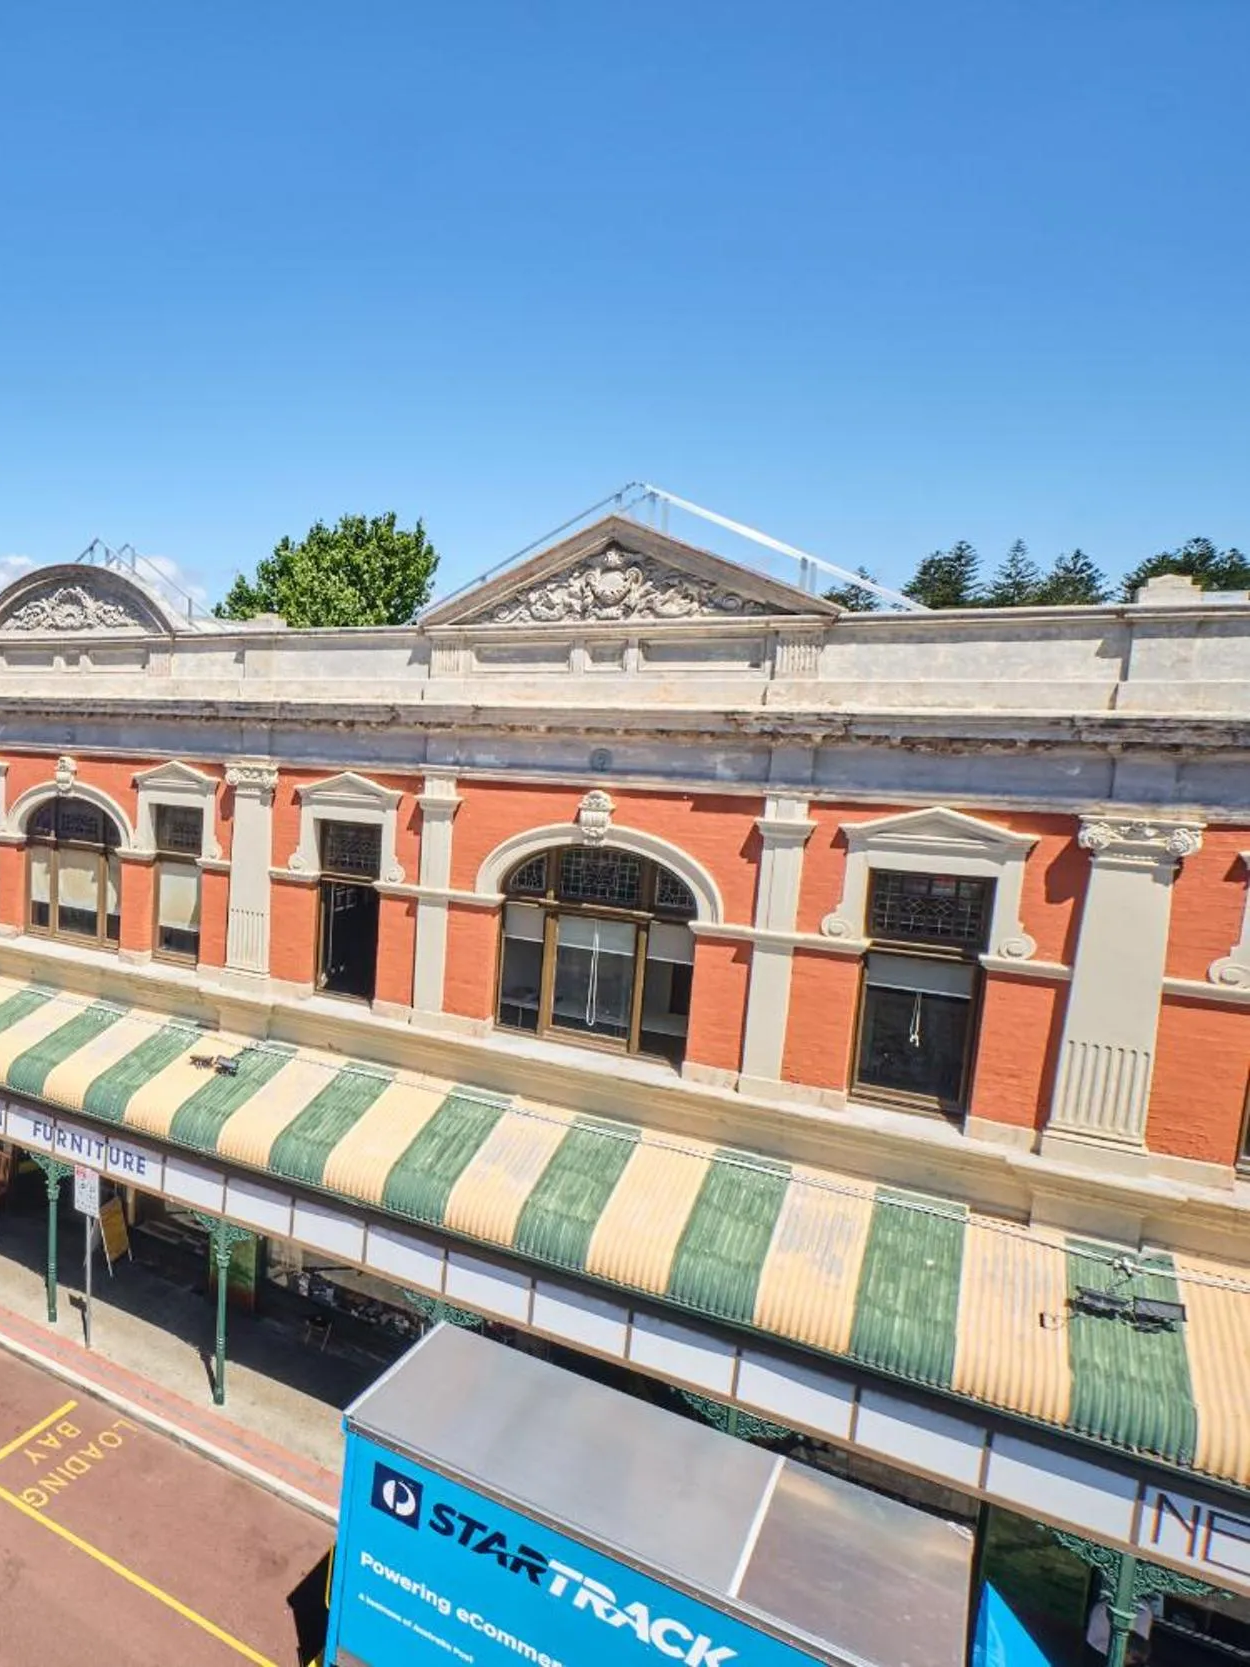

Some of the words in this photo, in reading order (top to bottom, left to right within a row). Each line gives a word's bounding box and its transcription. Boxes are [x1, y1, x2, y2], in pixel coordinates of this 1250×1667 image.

[32, 1119, 147, 1176] FURNITURE
[21, 1419, 138, 1508] LOADING
[24, 1421, 81, 1465] BAY
[360, 1551, 451, 1616] Powering
